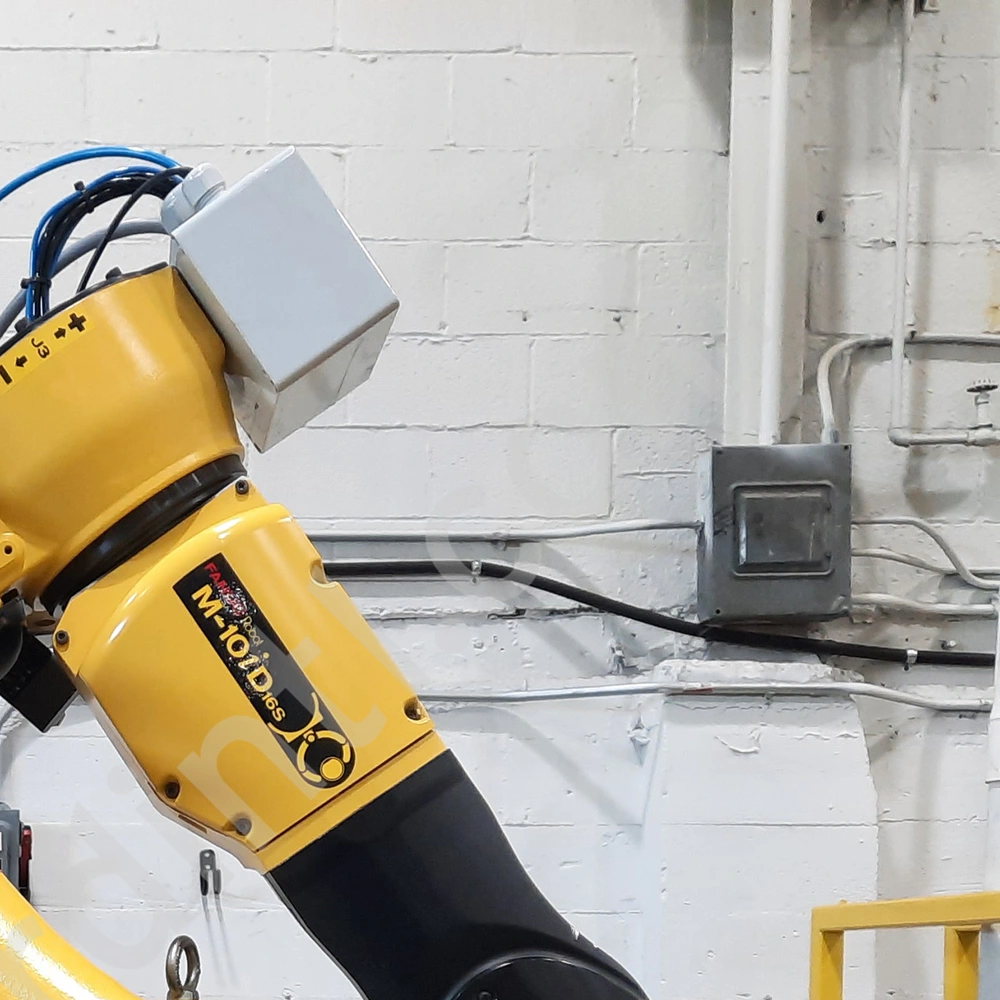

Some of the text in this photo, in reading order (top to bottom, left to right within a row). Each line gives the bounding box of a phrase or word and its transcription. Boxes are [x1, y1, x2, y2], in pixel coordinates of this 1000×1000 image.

[30, 337, 51, 359] J3
[204, 562, 264, 647] FAN Robot
